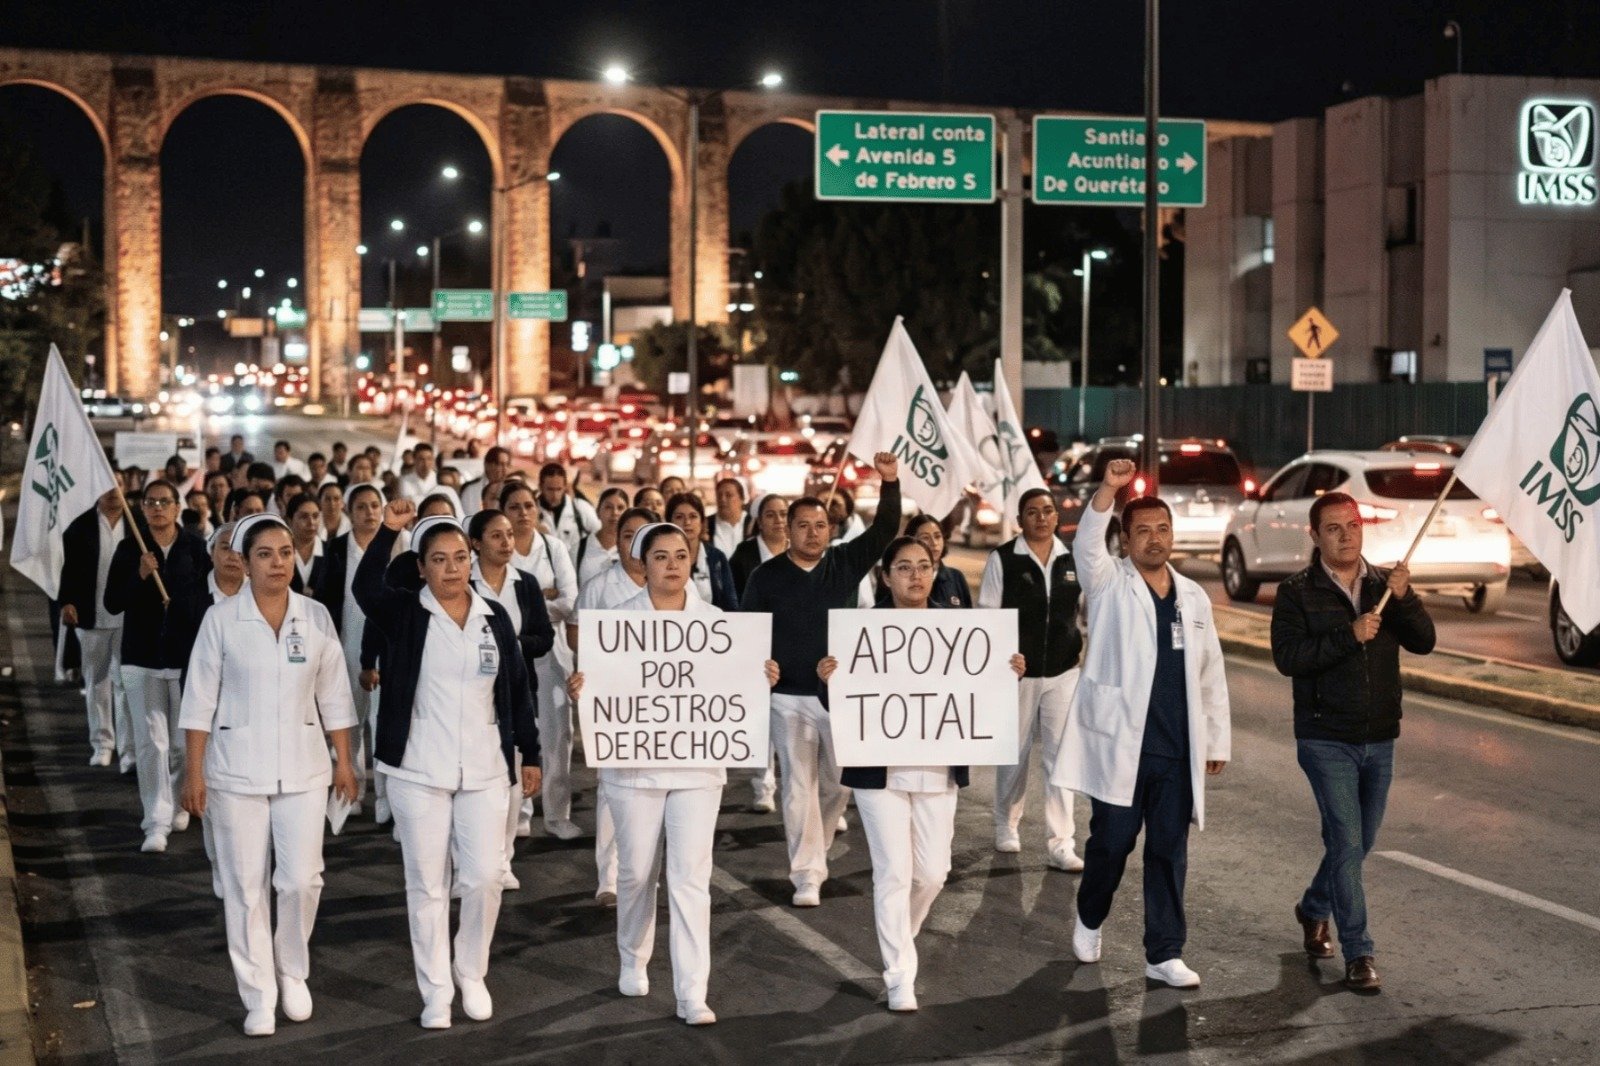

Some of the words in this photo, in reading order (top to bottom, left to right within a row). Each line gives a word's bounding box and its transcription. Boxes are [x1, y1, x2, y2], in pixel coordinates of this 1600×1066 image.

[855, 122, 925, 141] Lateral
[932, 125, 986, 142] conta
[1085, 127, 1170, 146] Santiao
[855, 147, 936, 165] Avenida
[855, 172, 879, 189] de
[885, 172, 957, 190] Febrero
[1043, 175, 1068, 193] De
[1074, 175, 1170, 195] Querétao
[1518, 171, 1597, 205] IMSS
[890, 435, 945, 488] IMSS
[1519, 460, 1584, 543] IMSS
[598, 619, 733, 654] UNIDOS
[849, 625, 991, 676] APOYO
[640, 660, 695, 689] POR
[593, 694, 747, 724] NUESTROS
[845, 693, 993, 741] TOTAL
